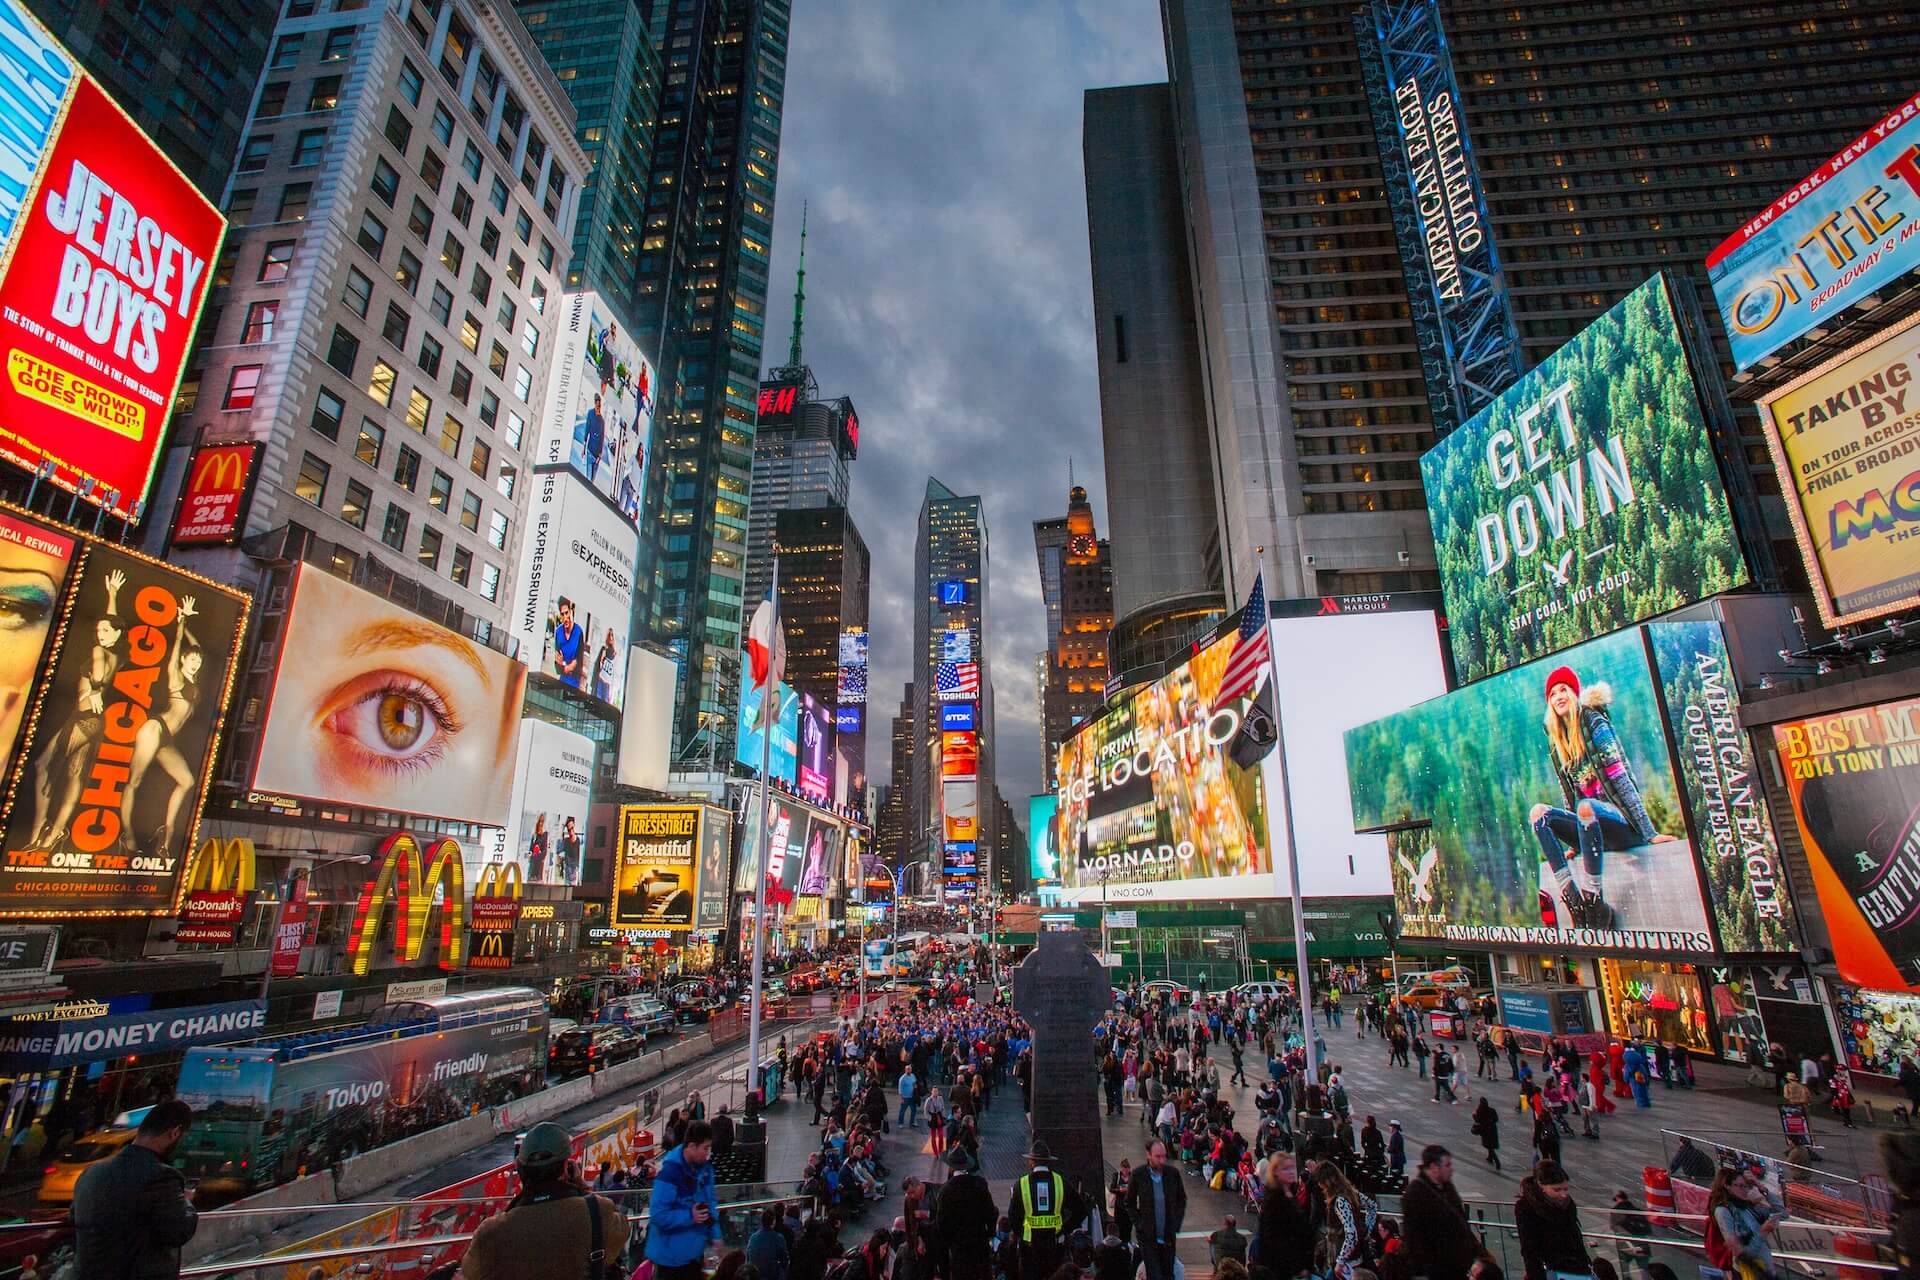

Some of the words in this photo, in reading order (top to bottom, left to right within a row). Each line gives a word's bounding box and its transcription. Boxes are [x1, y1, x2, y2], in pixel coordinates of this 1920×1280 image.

[1396, 78, 1431, 161] EAGLE
[1428, 92, 1483, 252] OUTFITTERS
[1744, 209, 1774, 238] NEW
[1778, 173, 1828, 210] YORK,
[1830, 137, 1869, 172] NEW
[46, 159, 205, 319] JERSEY
[1412, 158, 1463, 299] AMERICAN
[1731, 253, 1802, 334] ON
[1796, 185, 1905, 270] THE
[1810, 238, 1896, 312] BROADWAY'S
[52, 244, 167, 374] BOYS
[569, 291, 584, 333] RUNWAY
[4, 306, 20, 324] THE
[20, 316, 46, 338] STORY
[45, 330, 56, 343] OF
[103, 364, 110, 375] &
[18, 371, 76, 404] GOES
[71, 380, 138, 418] CROWD
[1787, 362, 1913, 435] TAKING
[1861, 388, 1908, 429] BY
[1487, 381, 1577, 490] GET
[1802, 462, 1821, 475] ON
[1822, 440, 1861, 464] TOUR
[1807, 470, 1853, 495] FINAL
[192, 506, 226, 523] 24
[193, 494, 235, 506] OPEN
[1476, 435, 1636, 577] DOWN
[25, 535, 64, 558] REVIVAL
[180, 524, 232, 537] HOURS
[523, 512, 550, 633] @EXPRESSRUNWAY
[1343, 595, 1391, 604] MARRIOTT
[1345, 603, 1386, 612] MARQUIS
[1509, 611, 1532, 632] STAY
[1535, 599, 1569, 620] COOL.
[1571, 585, 1596, 606] NOT
[938, 692, 977, 700] TOSHIBA
[71, 586, 178, 852] CHICAGO
[1101, 727, 1144, 762] PRIME
[1782, 714, 1870, 760] BEST
[1685, 705, 1736, 858] OUTFITTERS
[1792, 758, 1835, 780] 2014
[1835, 750, 1885, 773] TONY
[1695, 651, 1755, 807] AMERICAN
[1736, 816, 1784, 919] EAGLE
[8, 851, 49, 866] THE
[51, 853, 93, 868] ONE
[95, 854, 129, 869] THE
[131, 856, 177, 871] ONLY
[627, 840, 692, 857] Beautiful
[1083, 840, 1195, 873] VORNADO
[1855, 851, 1880, 873] A
[15, 882, 158, 893] CHICAGOTHEMUSICAL.COM
[1112, 887, 1154, 898] VNO.COM
[474, 902, 518, 912] McDonald's
[176, 930, 196, 938] OPEN
[207, 930, 232, 938] HOURS
[278, 921, 306, 938] JERSEY
[280, 936, 300, 951] BOYS
[589, 928, 618, 938] GIFTS
[624, 929, 673, 939] LUGGAGE
[1446, 925, 1520, 943] AMERICAN
[1526, 926, 1577, 945] EAGLE
[1582, 928, 1714, 952] OUTFITTERS
[12, 1009, 52, 1021] MONEY
[53, 1003, 110, 1020] EXCHANGE
[55, 1022, 163, 1055] MONEY
[169, 1009, 268, 1040] CHANGE
[491, 1023, 520, 1035] UNITED
[433, 1053, 488, 1082] friendly
[326, 1080, 384, 1111] Tokyo
